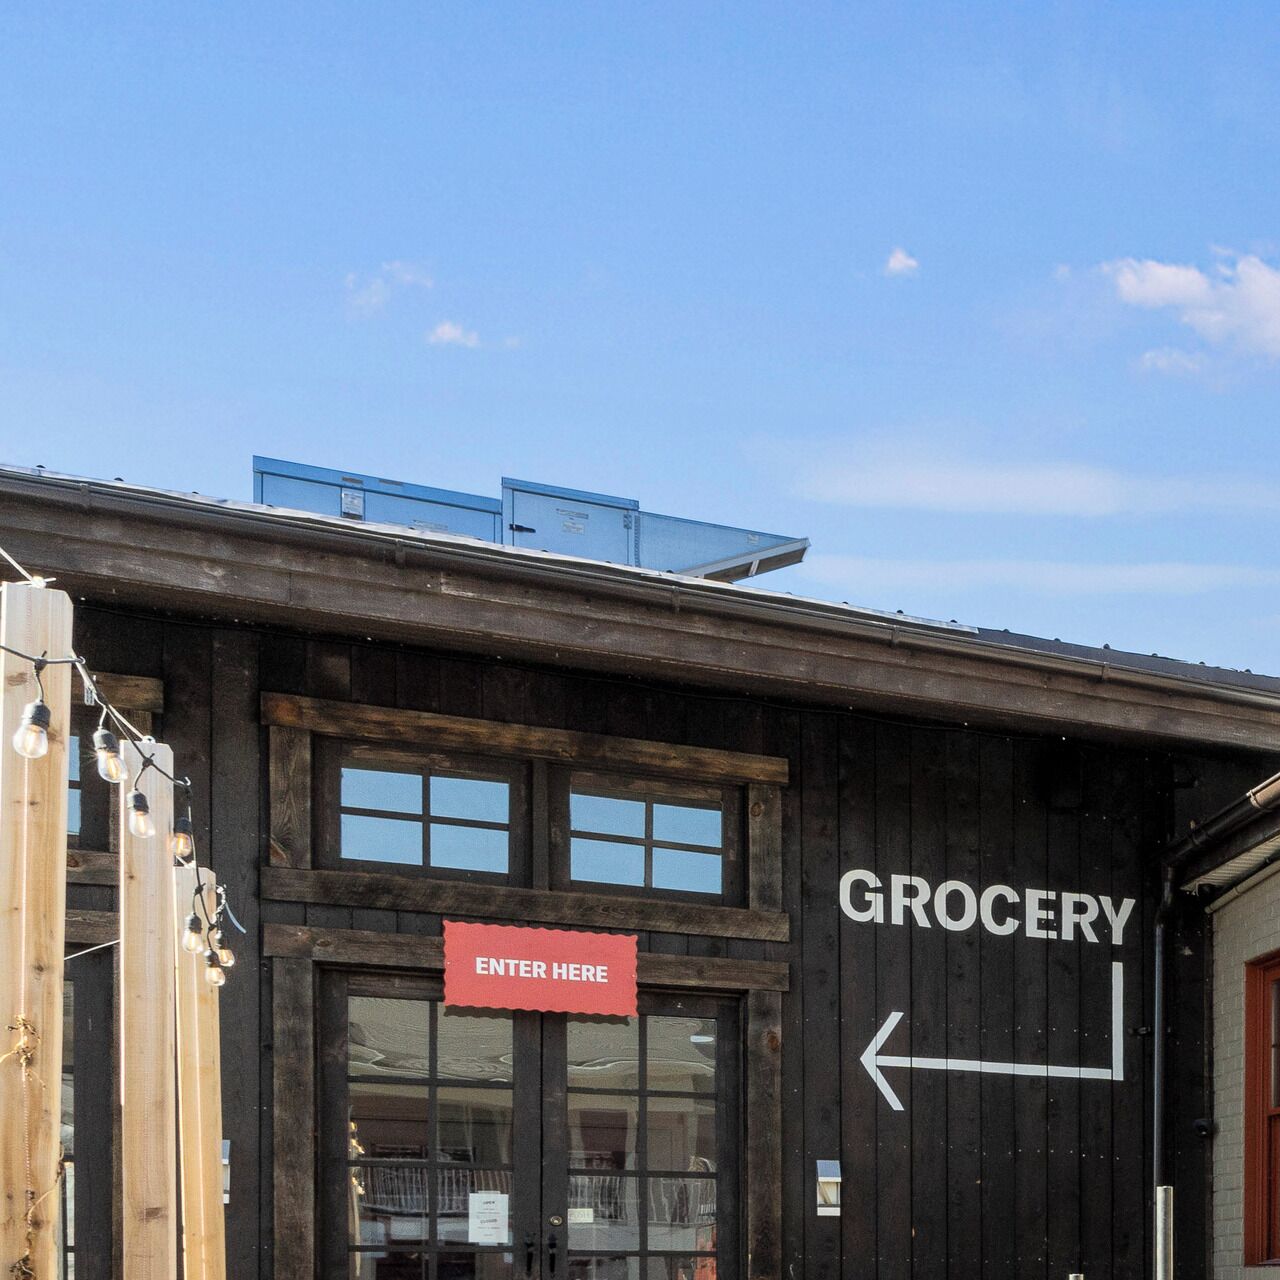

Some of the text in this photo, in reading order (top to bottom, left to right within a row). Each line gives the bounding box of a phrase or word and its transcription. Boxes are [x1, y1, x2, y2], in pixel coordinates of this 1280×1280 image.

[839, 868, 1136, 945] GROCERY
[475, 957, 608, 983] ENTER HERE
